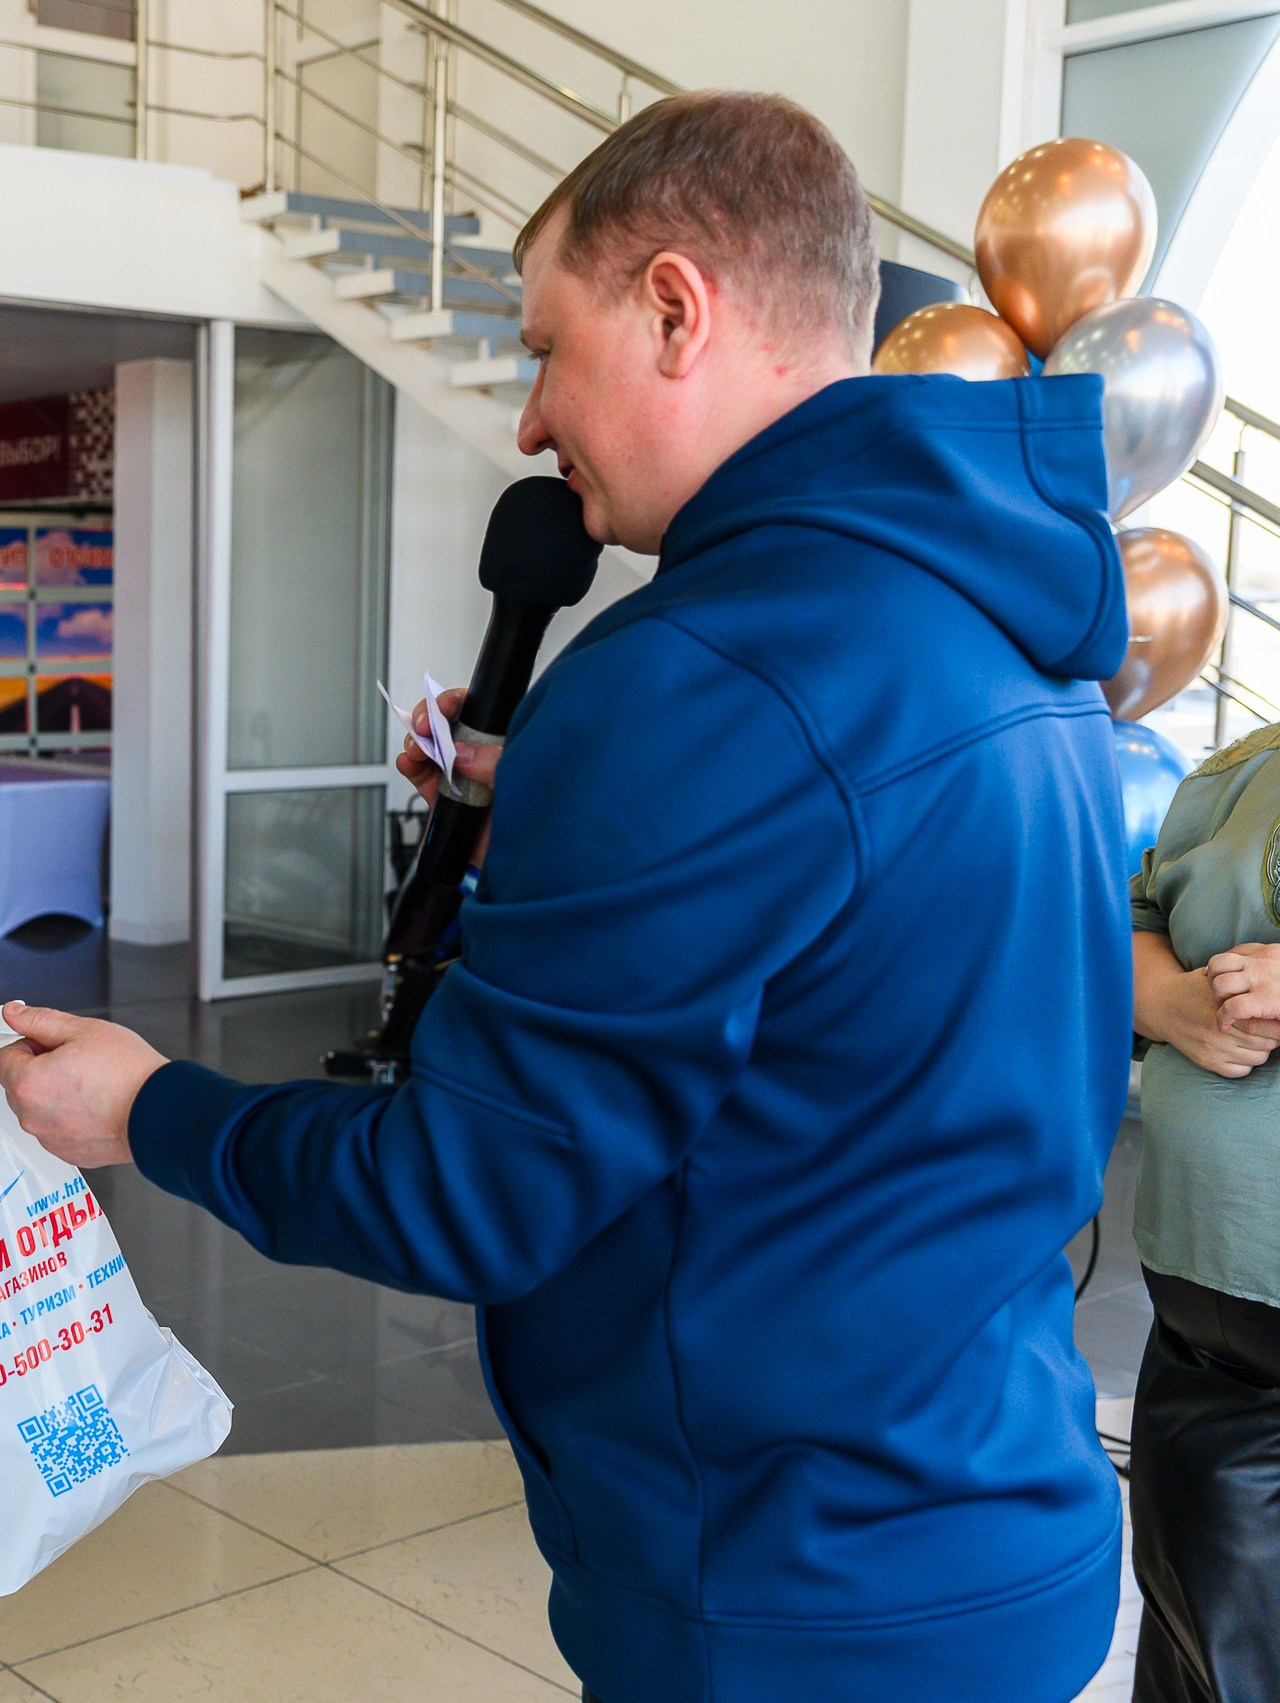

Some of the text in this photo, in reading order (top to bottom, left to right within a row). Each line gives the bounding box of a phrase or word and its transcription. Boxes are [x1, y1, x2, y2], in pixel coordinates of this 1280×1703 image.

[16, 1192, 103, 1257] ОТДЫ
[26, 1176, 86, 1217] www.hft
[20, 1284, 77, 1326] ТУРИЗМ
[86, 1252, 126, 1289] ТЕХНИ
